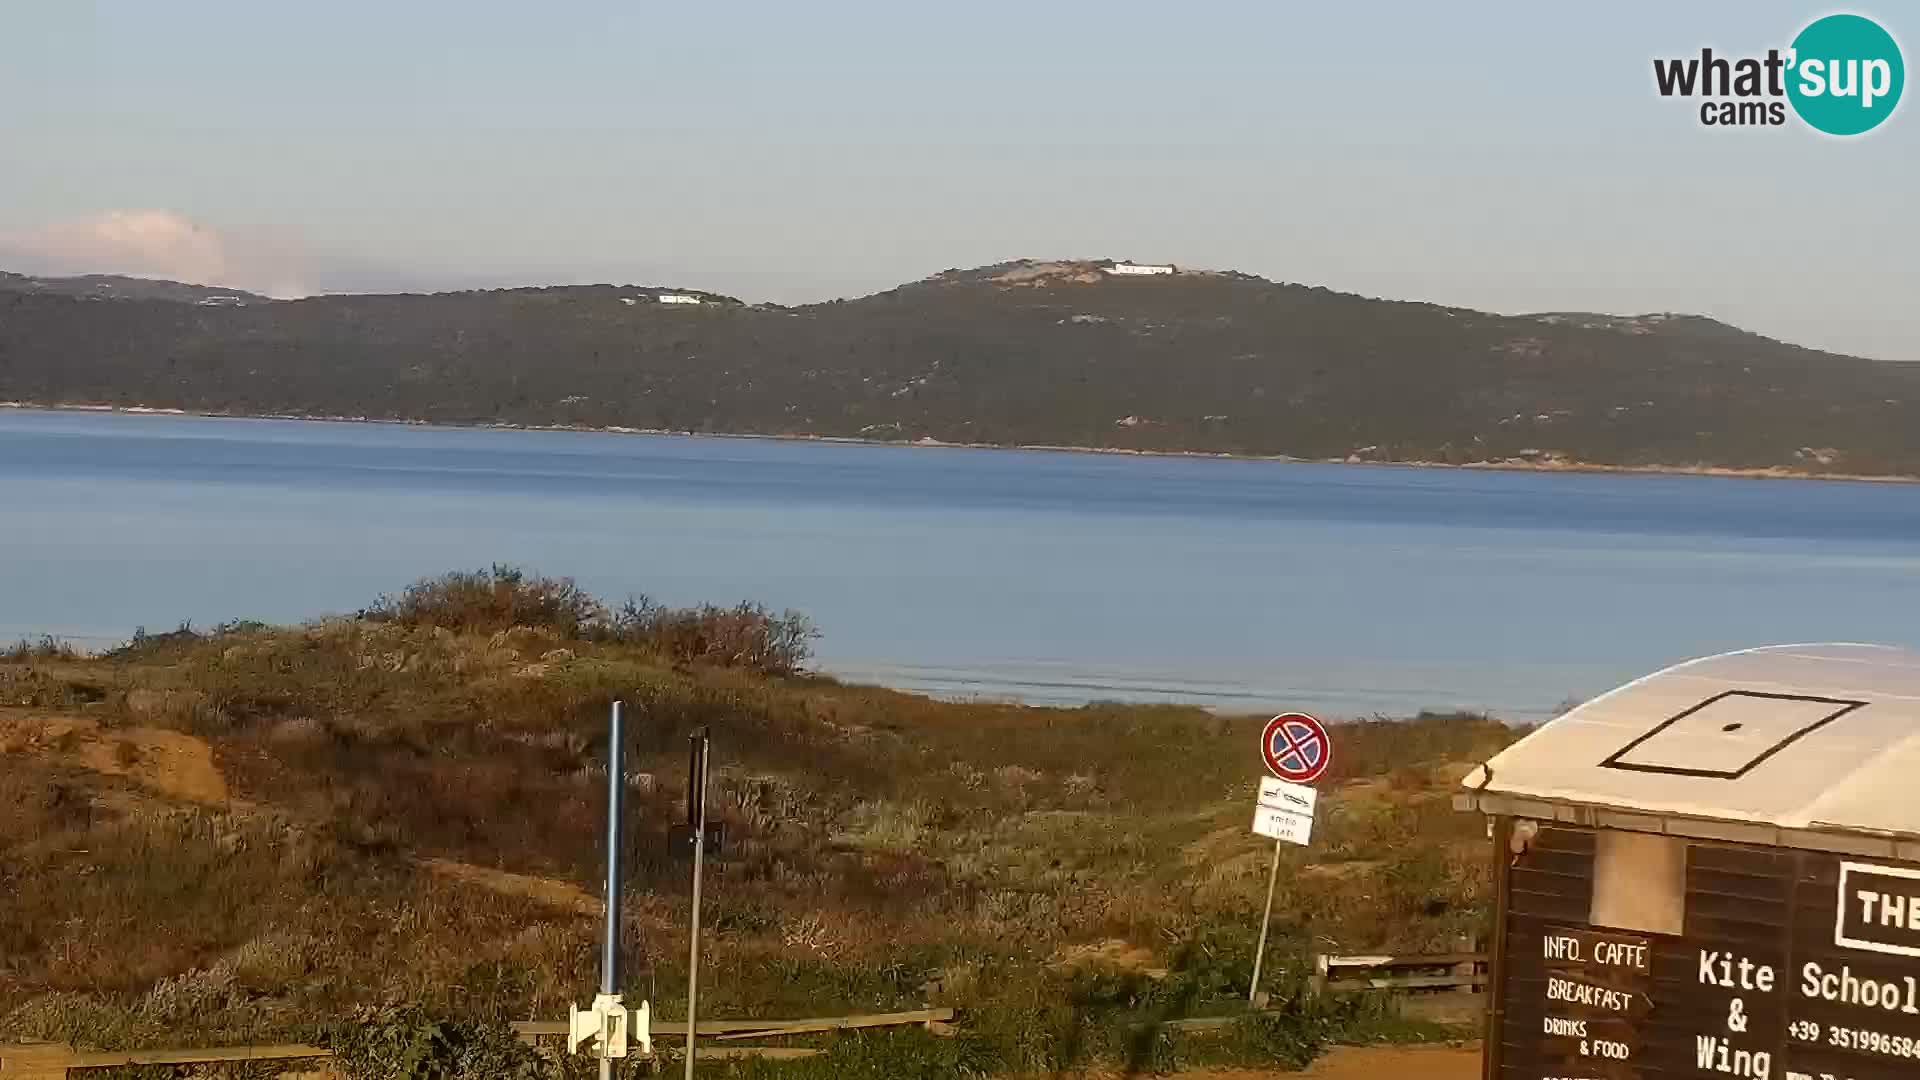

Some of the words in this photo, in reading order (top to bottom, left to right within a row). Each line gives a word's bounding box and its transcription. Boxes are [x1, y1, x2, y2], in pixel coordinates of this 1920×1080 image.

[1857, 890, 1920, 930] THE
[1546, 977, 1632, 1011] BREAKFAST
[1699, 949, 1775, 992] Kite
[1801, 962, 1919, 1014] School
[1543, 1017, 1587, 1037] DRINKS
[1727, 998, 1748, 1032] &
[1580, 1041, 1589, 1056] &
[1593, 1040, 1629, 1060] FOOD
[1696, 1035, 1771, 1080] Wing
[1788, 1021, 1820, 1042] +39
[1828, 1026, 1920, 1059] 351996584
